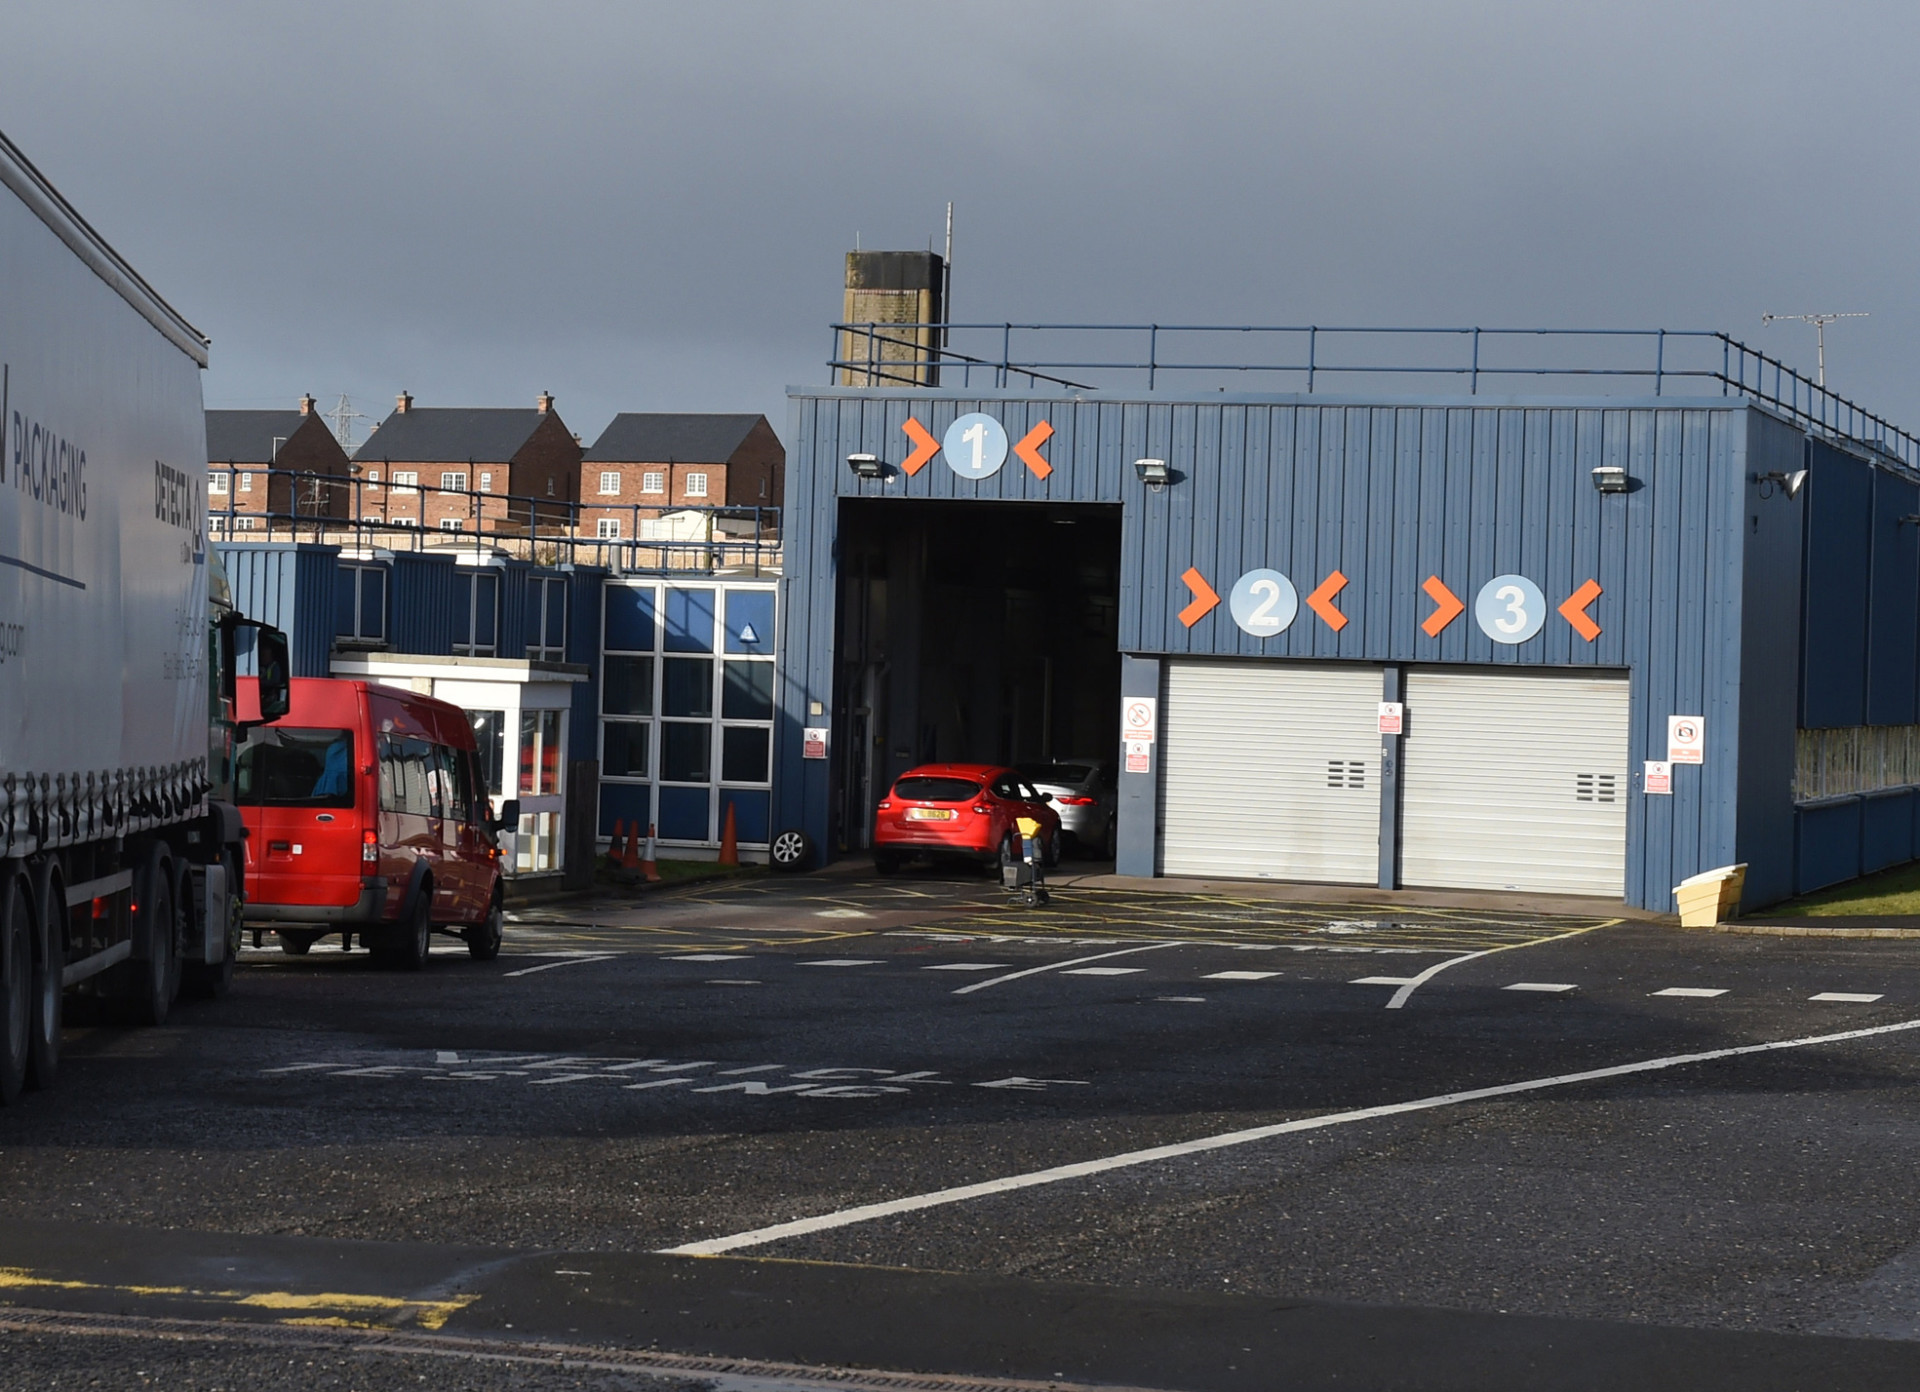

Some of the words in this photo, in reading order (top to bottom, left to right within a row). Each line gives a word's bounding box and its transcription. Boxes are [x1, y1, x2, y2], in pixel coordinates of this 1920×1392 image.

[14, 409, 87, 522] PACKAGING
[961, 422, 987, 471] 1
[155, 459, 192, 530] DETECTA
[1247, 578, 1281, 626] 2
[1493, 585, 1527, 634] 3
[259, 1062, 913, 1098] TESTING
[434, 1051, 1091, 1091] VEHICLE
